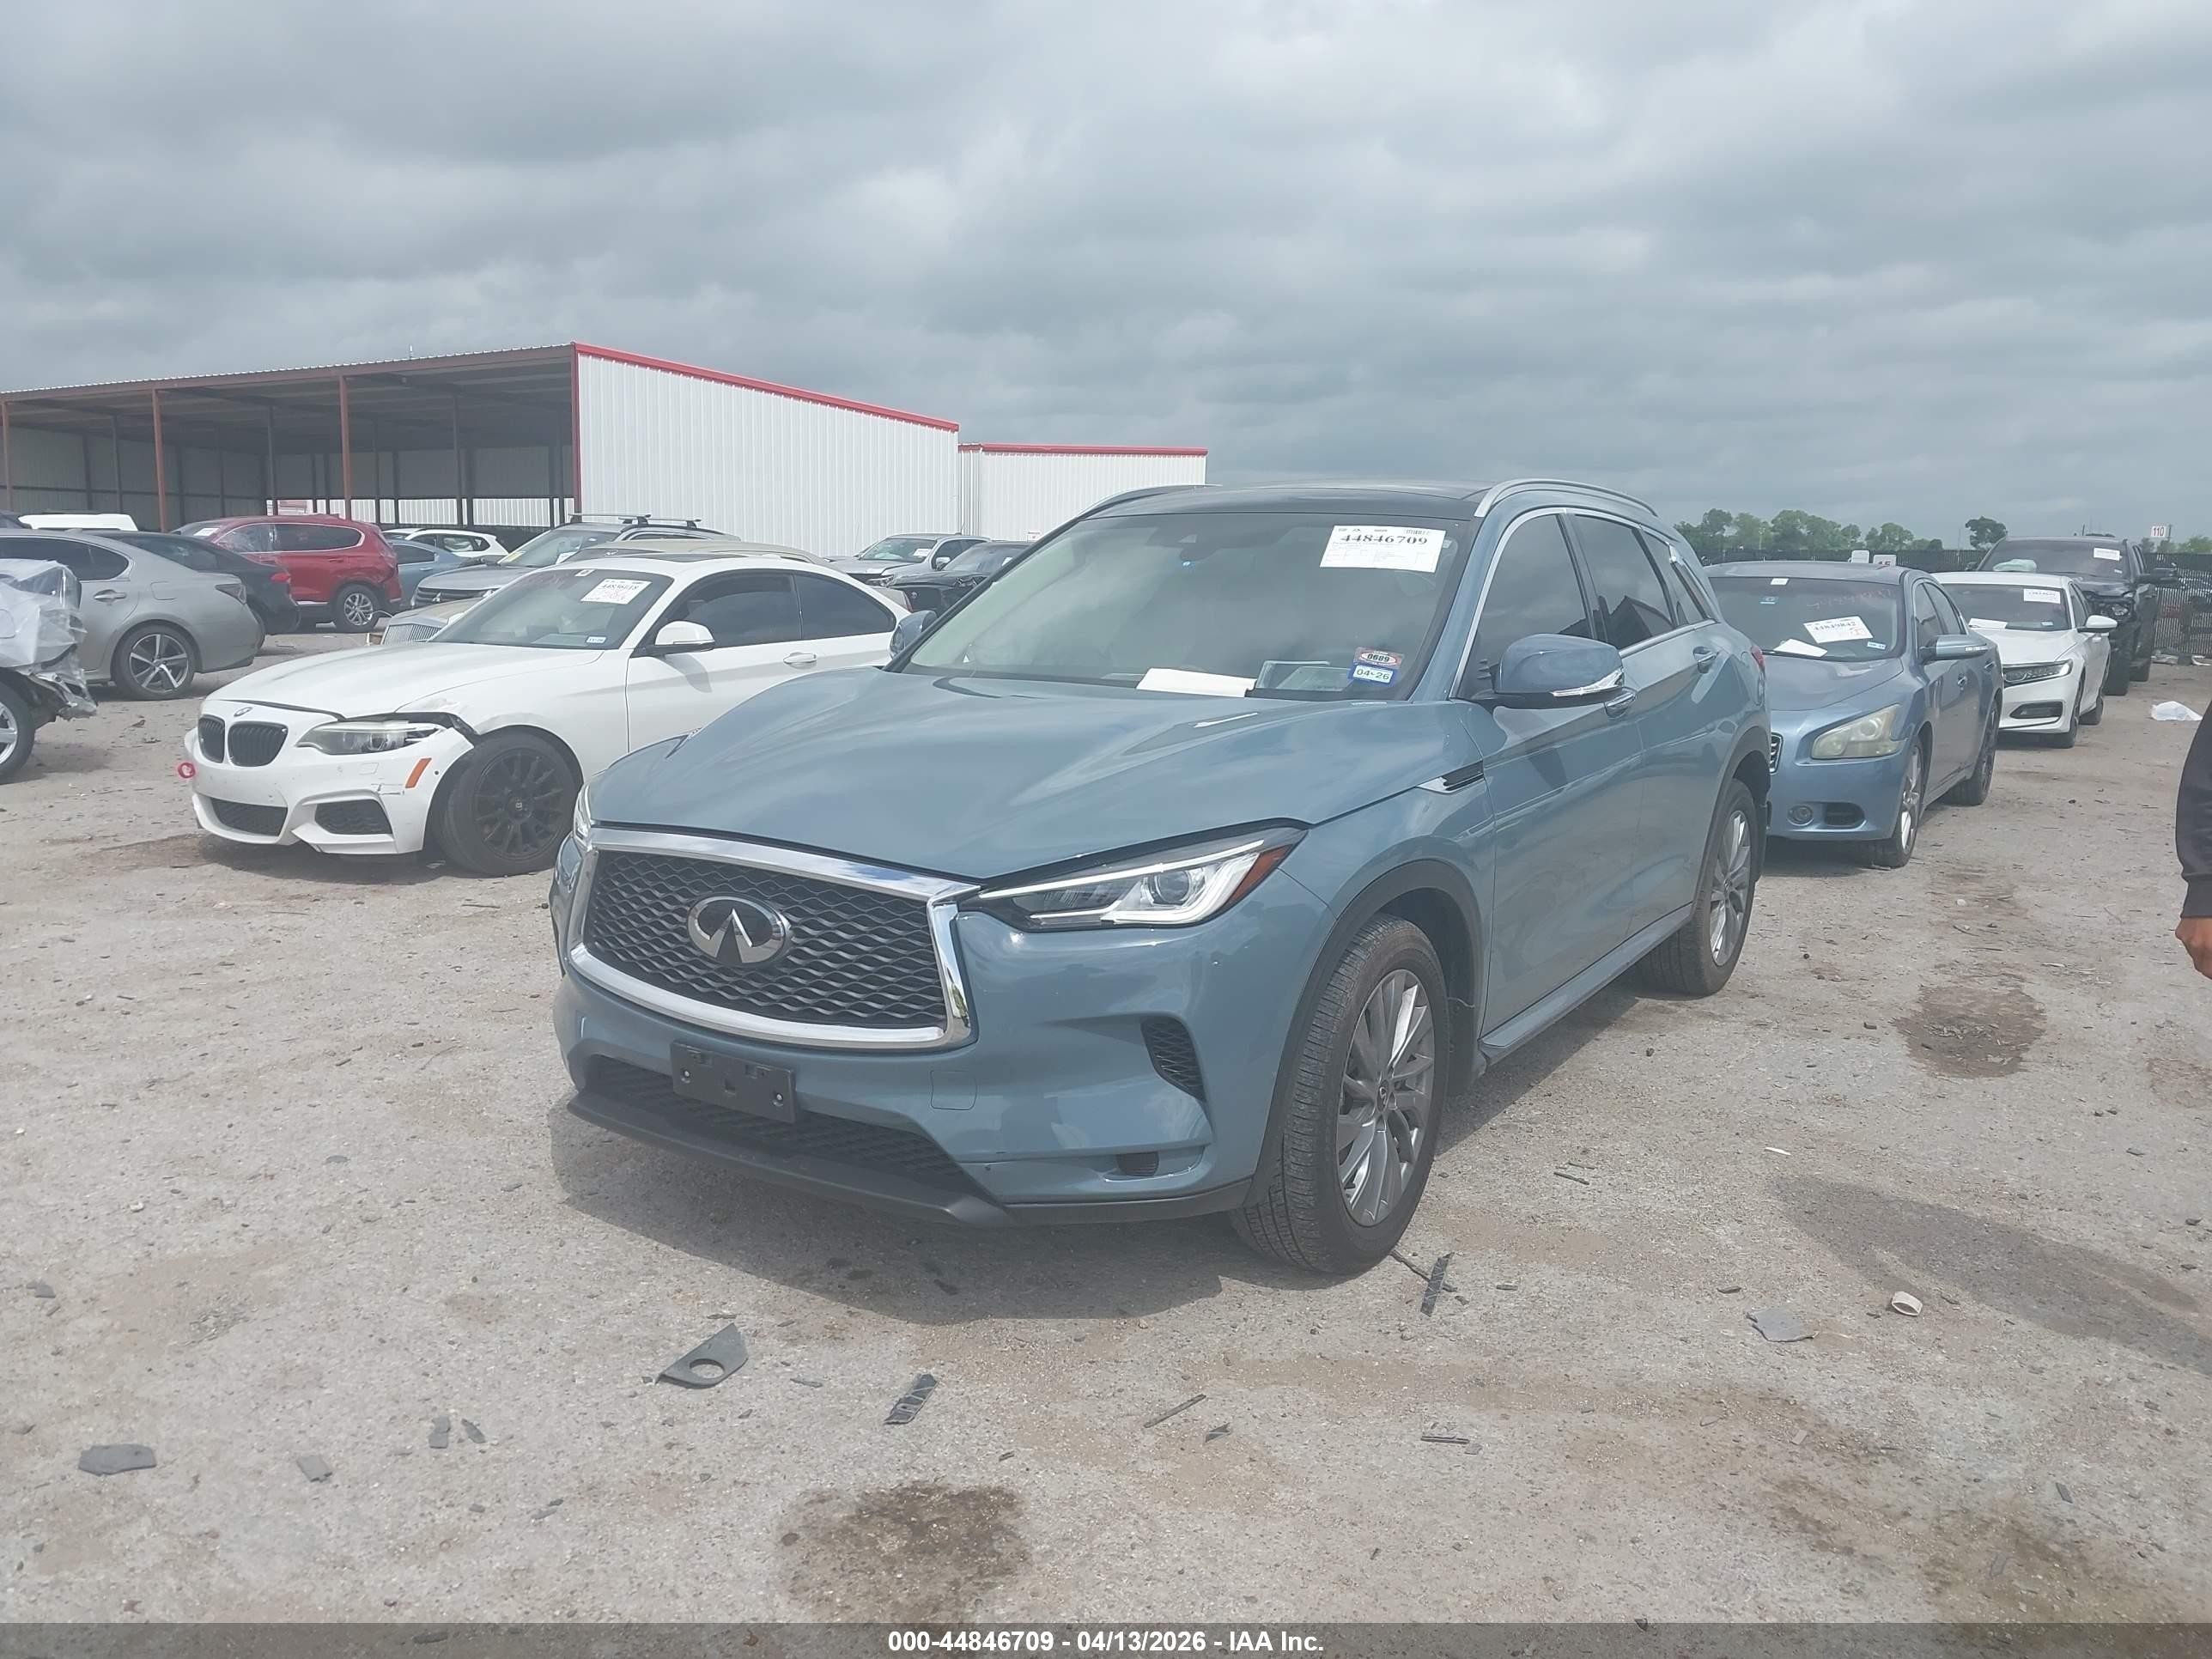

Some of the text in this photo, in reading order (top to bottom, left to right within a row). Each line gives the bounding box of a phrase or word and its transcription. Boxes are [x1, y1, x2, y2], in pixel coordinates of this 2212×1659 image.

[2153, 527, 2165, 537] 110
[1340, 534, 1428, 544] 44846709
[1357, 669, 1389, 680] 04-26
